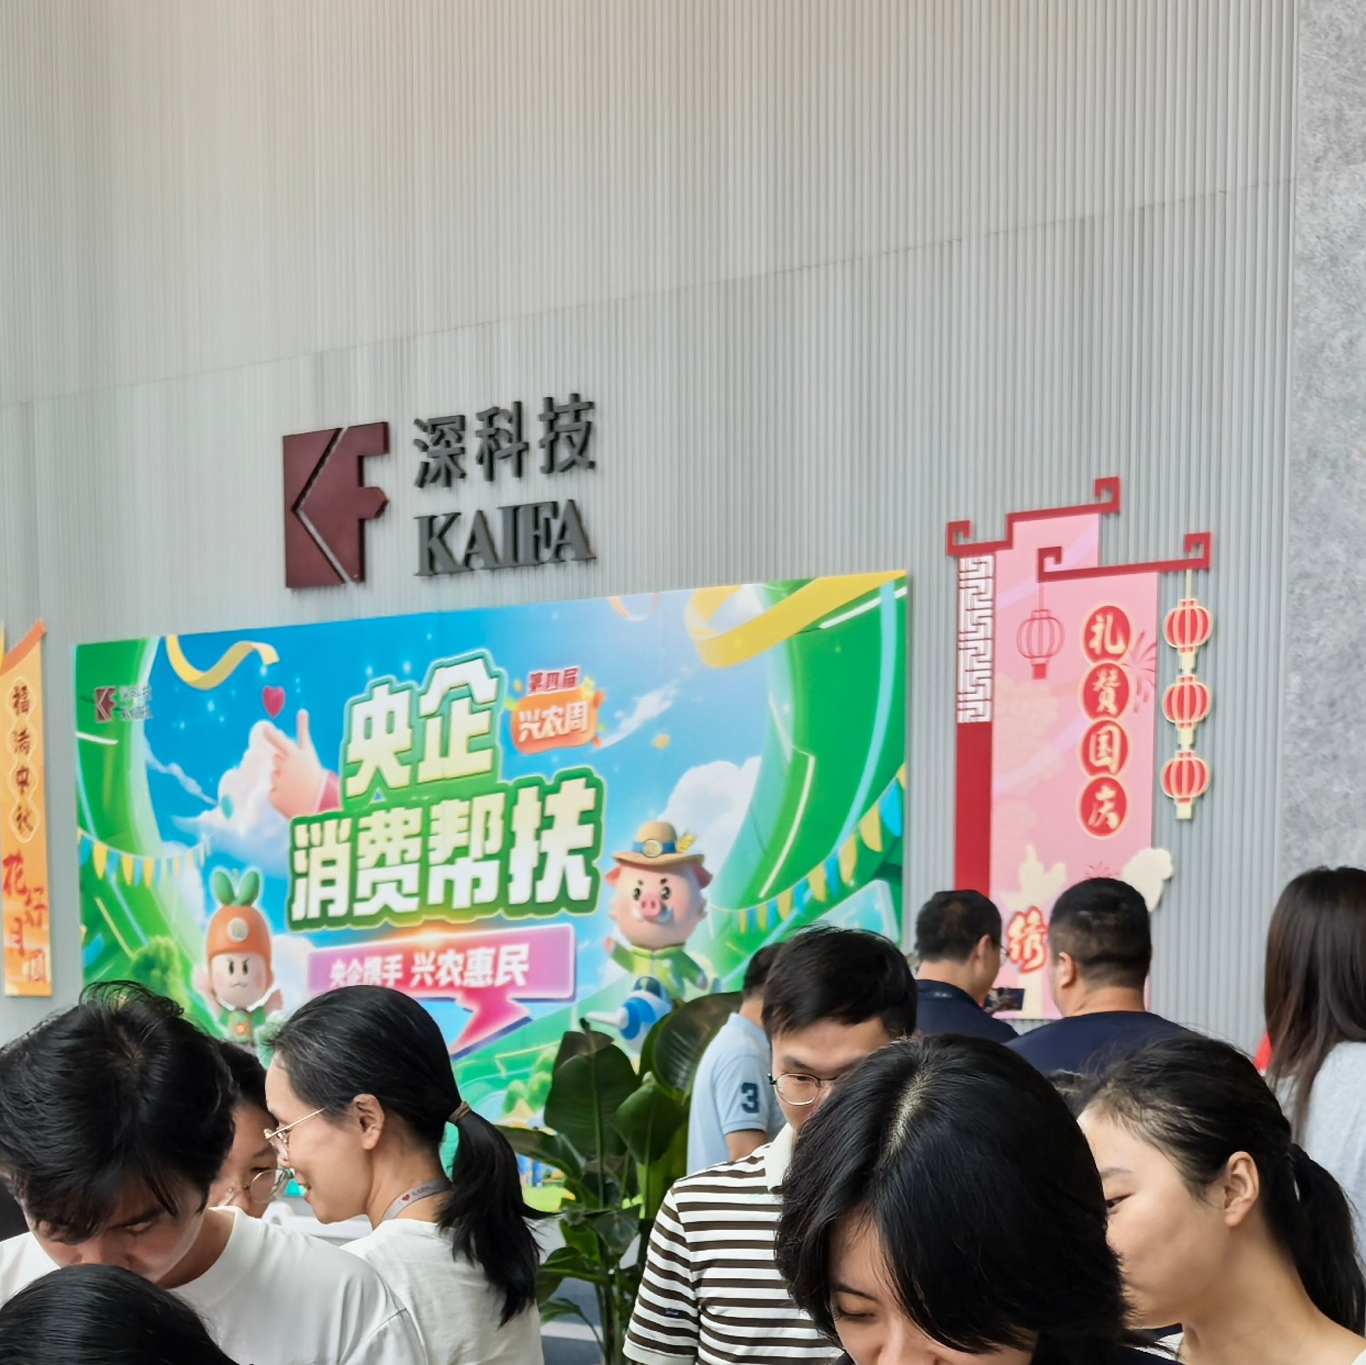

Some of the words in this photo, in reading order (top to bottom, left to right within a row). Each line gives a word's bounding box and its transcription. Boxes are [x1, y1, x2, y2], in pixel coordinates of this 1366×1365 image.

[413, 392, 597, 488] 深科技
[413, 499, 597, 577] KAIFA
[528, 667, 579, 691] 第四届
[346, 658, 499, 798] 央企
[519, 701, 588, 743] 兴农周
[291, 777, 597, 921] 消费帮扶
[329, 953, 404, 988] 央企携手
[411, 943, 530, 988] 兴农惠民
[741, 1082, 760, 1114] 3
